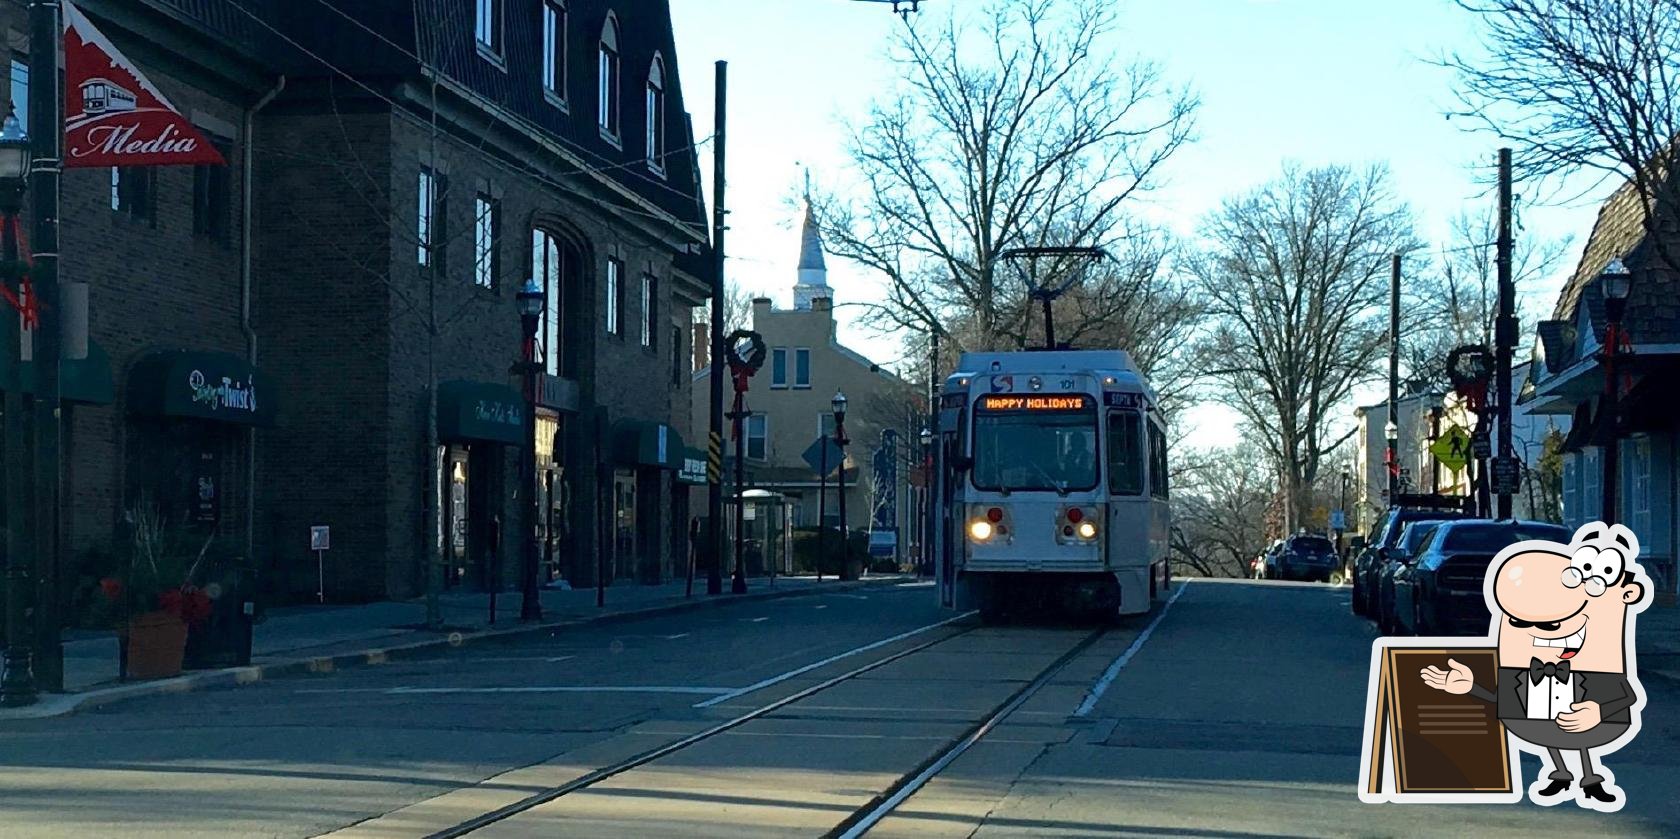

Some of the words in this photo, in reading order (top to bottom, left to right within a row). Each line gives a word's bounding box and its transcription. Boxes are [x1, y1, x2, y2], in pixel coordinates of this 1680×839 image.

[71, 122, 198, 158] Media
[1060, 380, 1075, 390] 101
[986, 398, 1023, 409] HAPPY
[1026, 398, 1083, 409] HOLIDAYS
